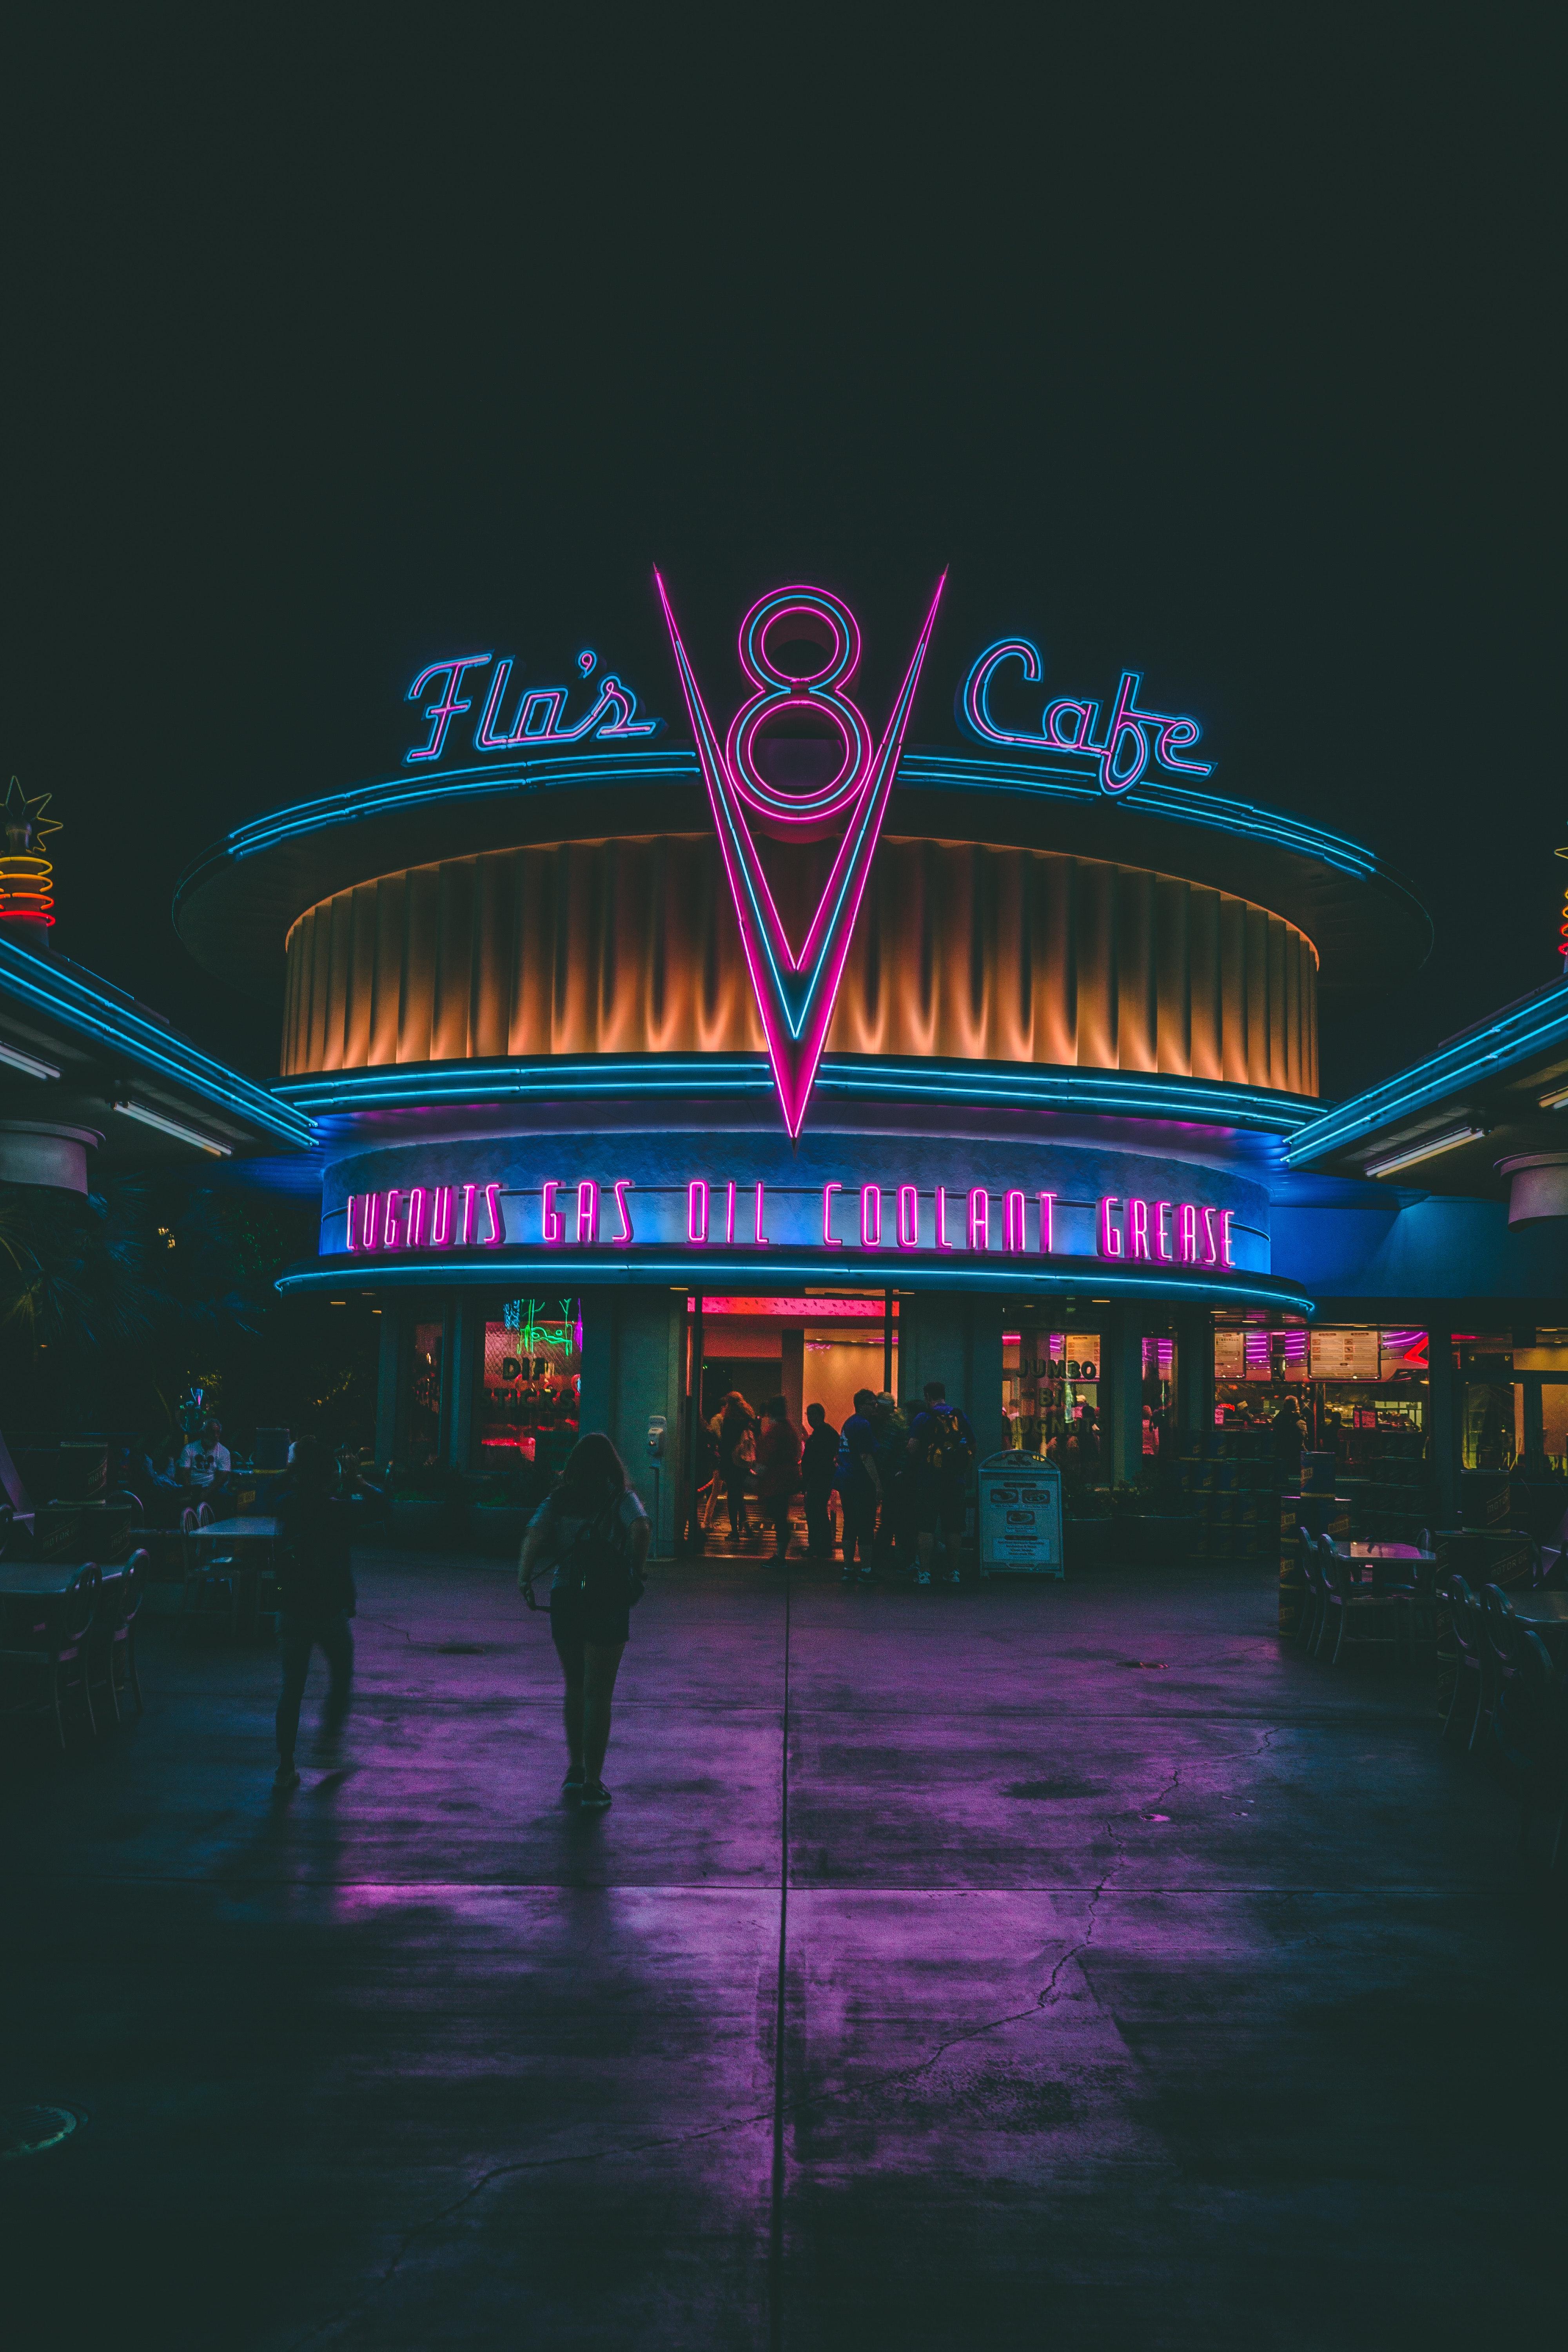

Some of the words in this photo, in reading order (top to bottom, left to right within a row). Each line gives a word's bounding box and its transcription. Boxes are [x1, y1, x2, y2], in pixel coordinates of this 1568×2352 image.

[402, 648, 664, 767] Flo's
[956, 635, 1218, 796] Cafe
[347, 1182, 506, 1251] LUGNUTS
[542, 1180, 635, 1244] GAS
[688, 1180, 769, 1244] OIL
[824, 1182, 1058, 1253] COOLANT
[1101, 1196, 1236, 1267] GREASE
[1016, 1359, 1096, 1379] JUMBO
[481, 1389, 576, 1410] STICKS
